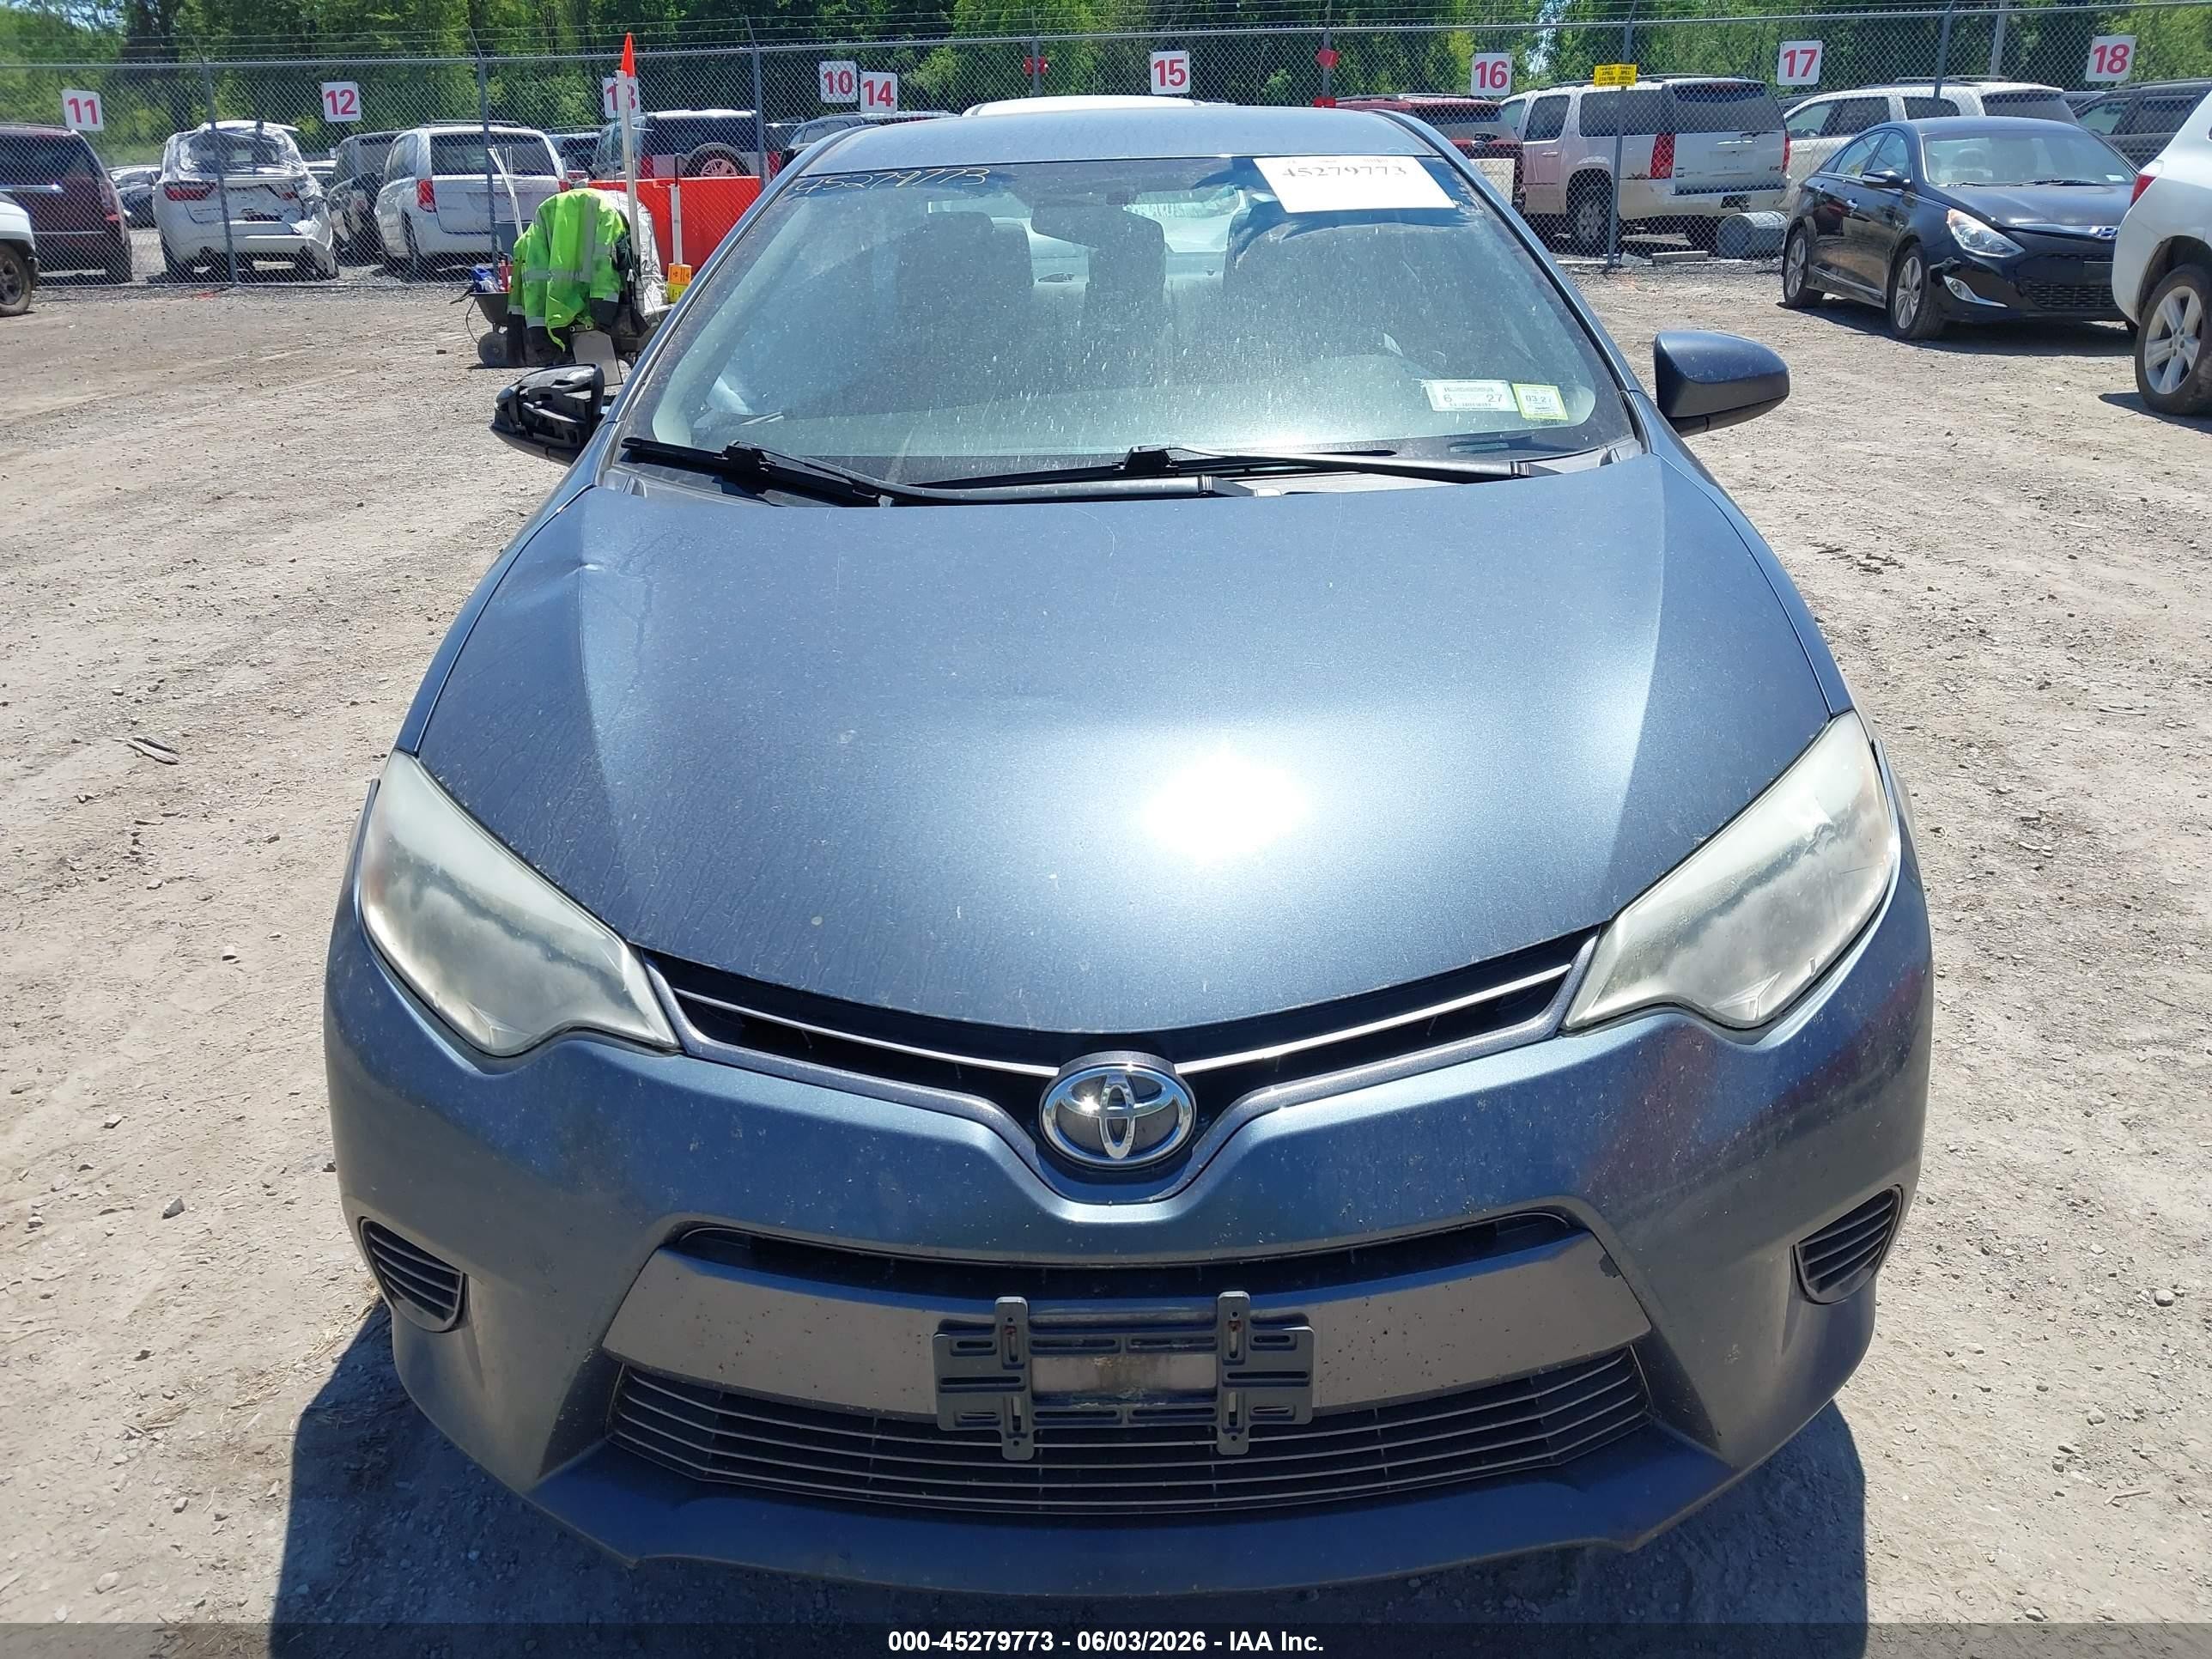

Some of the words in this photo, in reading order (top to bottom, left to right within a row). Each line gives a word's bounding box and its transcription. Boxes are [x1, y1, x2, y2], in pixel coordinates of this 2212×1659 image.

[1153, 58, 1187, 87] 15
[1784, 49, 1817, 77] 17
[2094, 44, 2130, 74] 18
[823, 70, 853, 94] 10
[1474, 60, 1508, 88] 16
[325, 88, 357, 115] 12
[863, 79, 894, 106] 14
[68, 97, 98, 125] 11
[795, 167, 990, 195] 45279773
[1283, 166, 1407, 177] 45279773
[1486, 393, 1503, 403] 27
